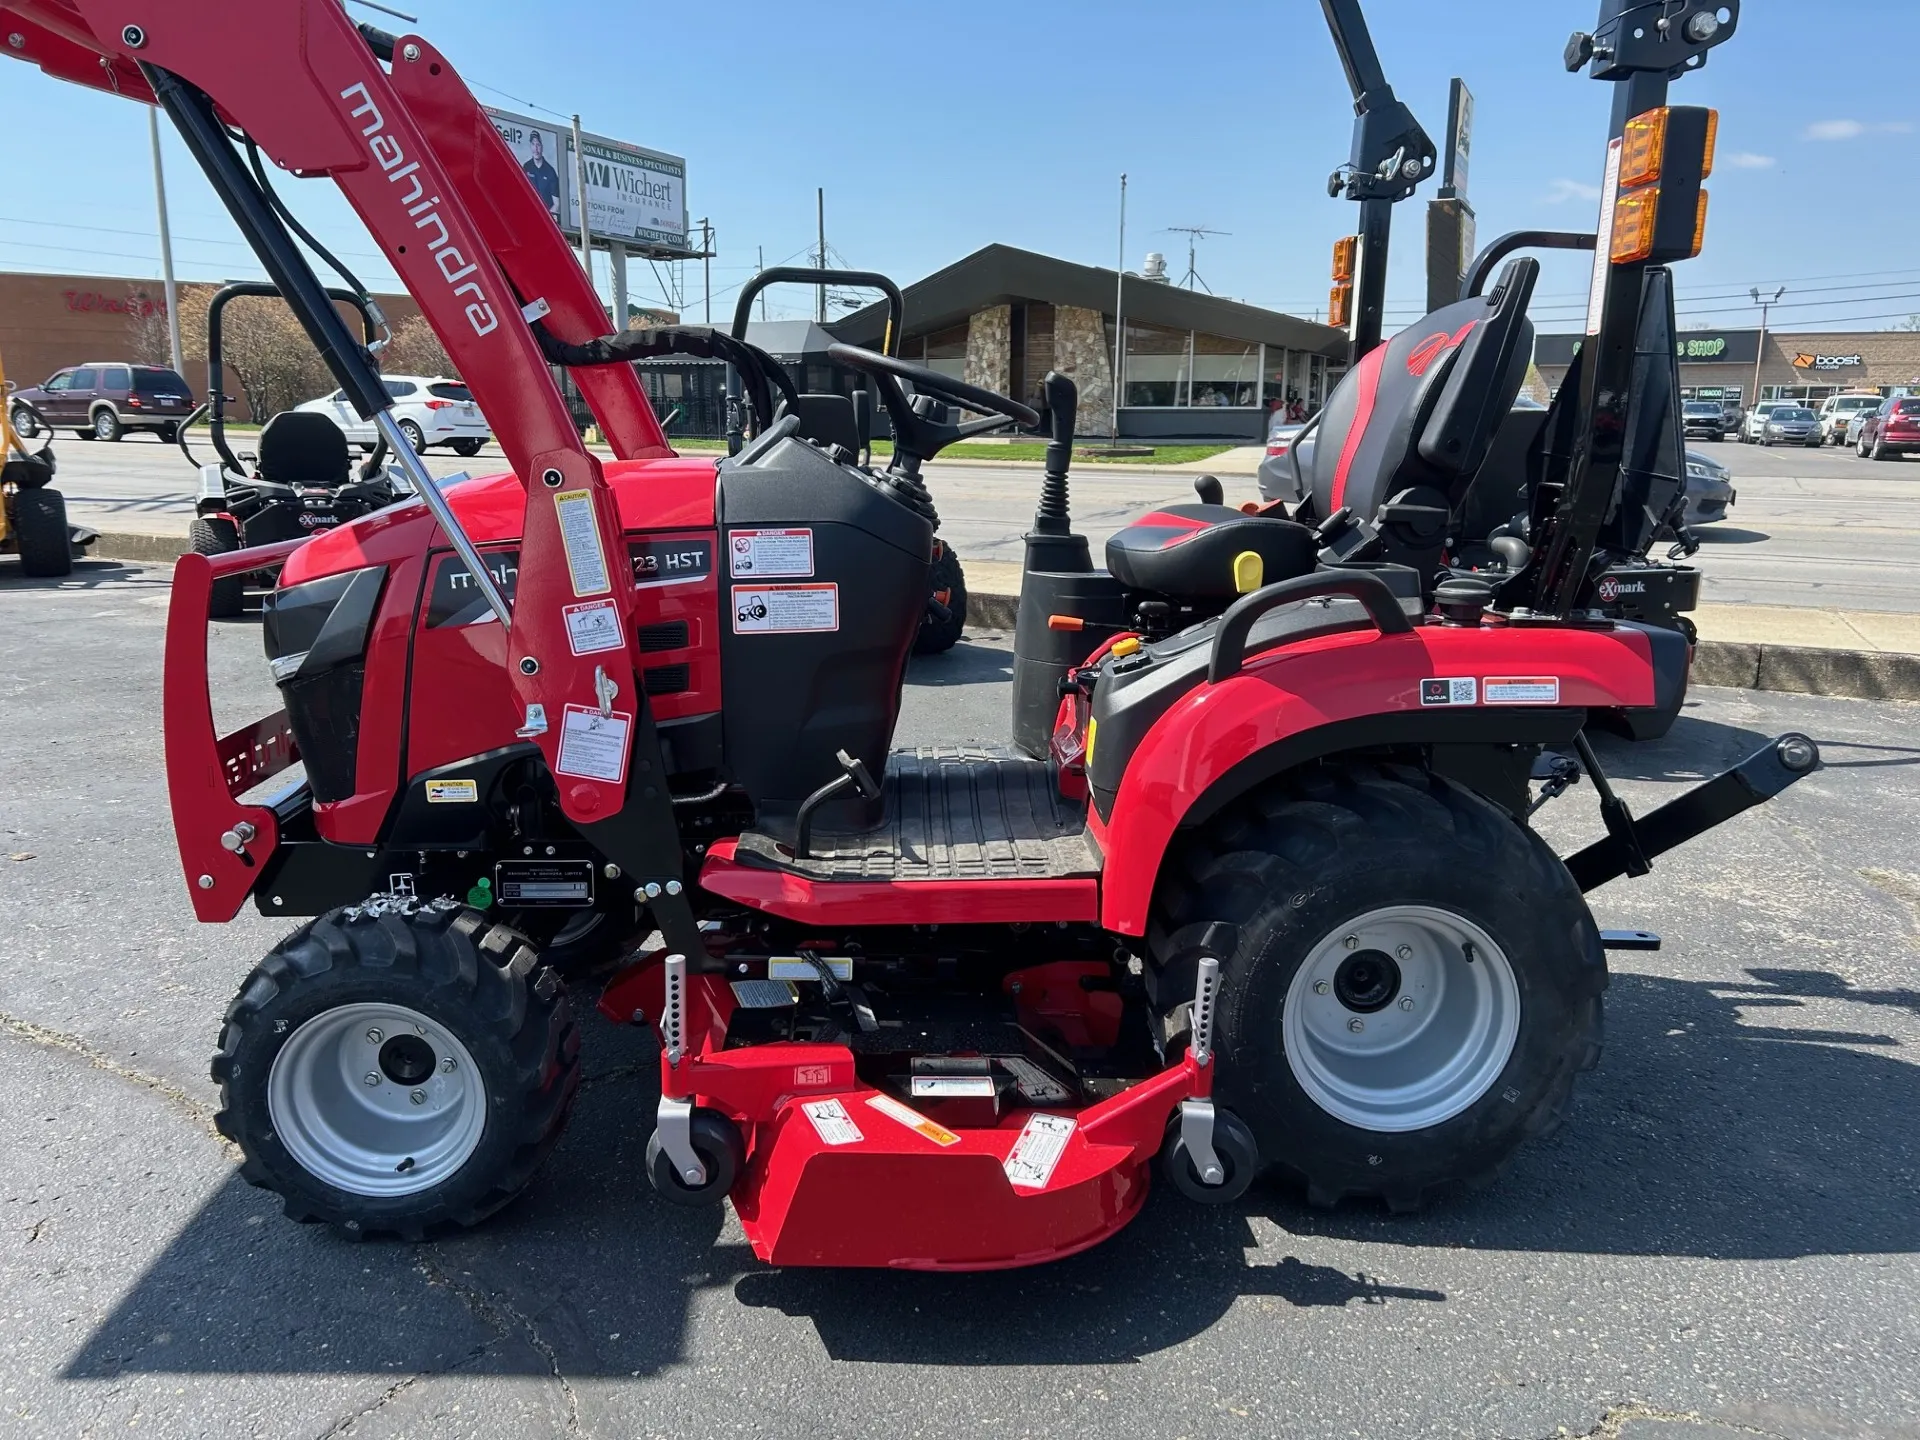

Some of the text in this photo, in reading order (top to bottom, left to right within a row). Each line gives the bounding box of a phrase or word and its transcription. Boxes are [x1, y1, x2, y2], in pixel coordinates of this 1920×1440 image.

[613, 152, 643, 165] BUSINESS
[644, 160, 682, 176] SPECIALISTS
[612, 166, 672, 202] Wichert
[341, 81, 498, 337] mahindra
[607, 205, 625, 215] FROM
[616, 193, 672, 211] INSURANCE
[1687, 338, 1725, 356] SHOP
[1815, 354, 1860, 365] boost
[1699, 389, 1722, 397] TOBACCO
[564, 492, 587, 500] CAUTION
[665, 551, 704, 570] HST
[1599, 580, 1646, 598] eXmark
[580, 602, 607, 612] DANGER
[588, 709, 614, 719] DANR
